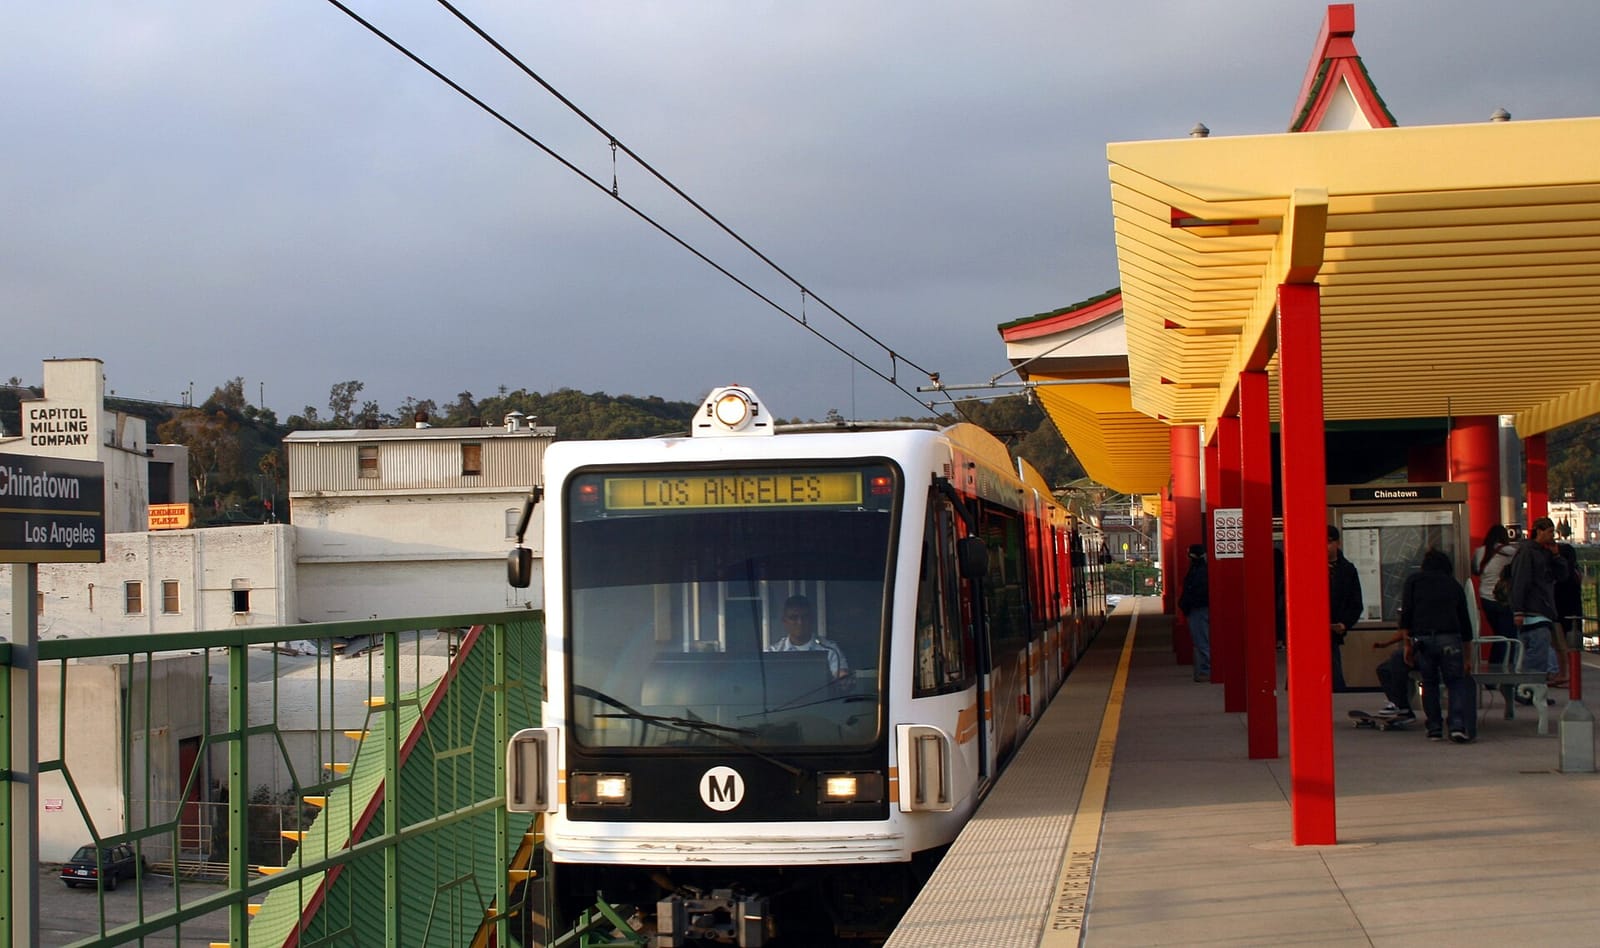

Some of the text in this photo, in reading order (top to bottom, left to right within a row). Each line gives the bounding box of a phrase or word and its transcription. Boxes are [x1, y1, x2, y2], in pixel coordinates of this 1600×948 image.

[31, 408, 87, 420] CAPITOL
[31, 421, 88, 433] MILLING
[31, 434, 88, 446] COMPANY
[0, 465, 79, 499] Chinatown
[643, 476, 821, 506] LOS ANGELES
[1374, 490, 1418, 498] Chinatown
[25, 520, 95, 548] Los Angeles
[709, 775, 736, 803] M
